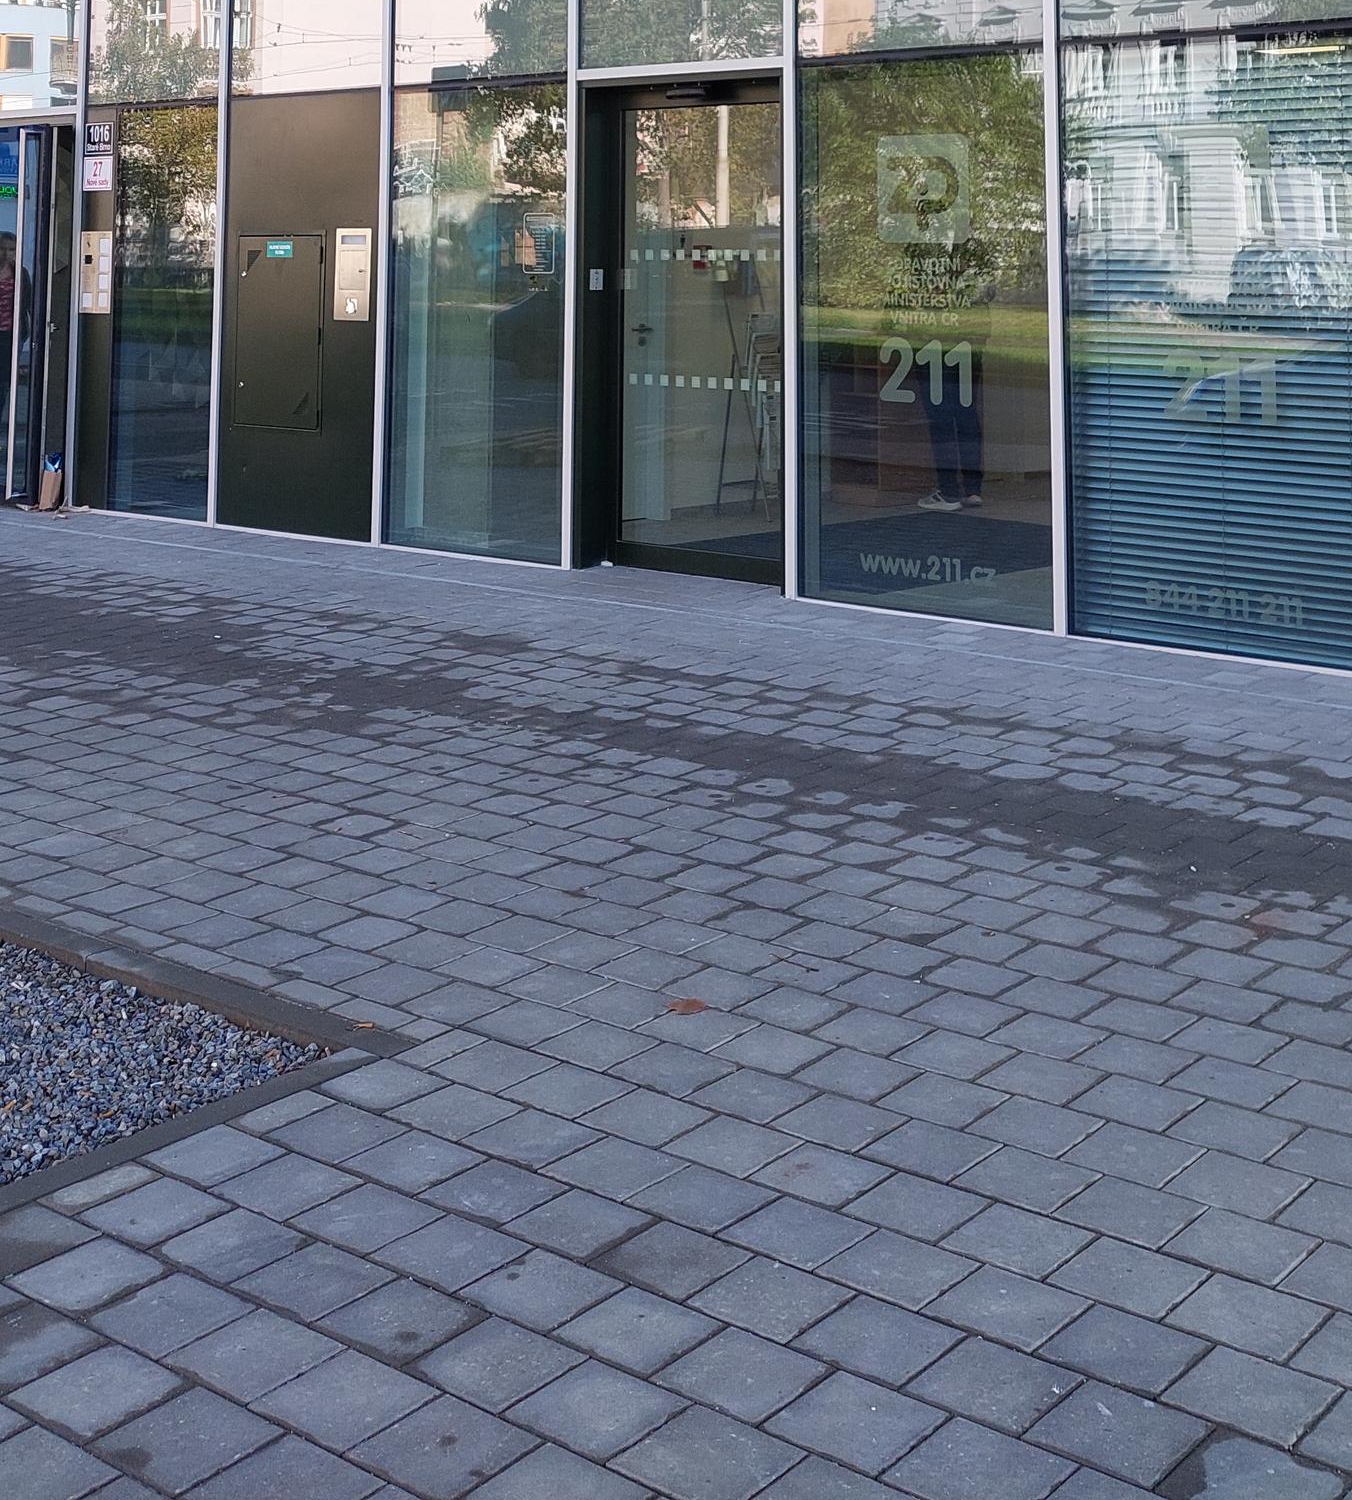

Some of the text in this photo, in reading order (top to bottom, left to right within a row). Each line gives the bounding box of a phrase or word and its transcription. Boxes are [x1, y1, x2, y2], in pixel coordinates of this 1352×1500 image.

[90, 125, 110, 142] 1016
[93, 161, 103, 176] 27
[889, 254, 961, 272] DRAVOTNÍ
[889, 310, 937, 325] VNITRA
[879, 337, 973, 408] 211
[1163, 348, 1277, 426] 211
[859, 553, 997, 586] www.211.cz
[1208, 587, 1249, 621] 211
[1259, 594, 1303, 628] 211
